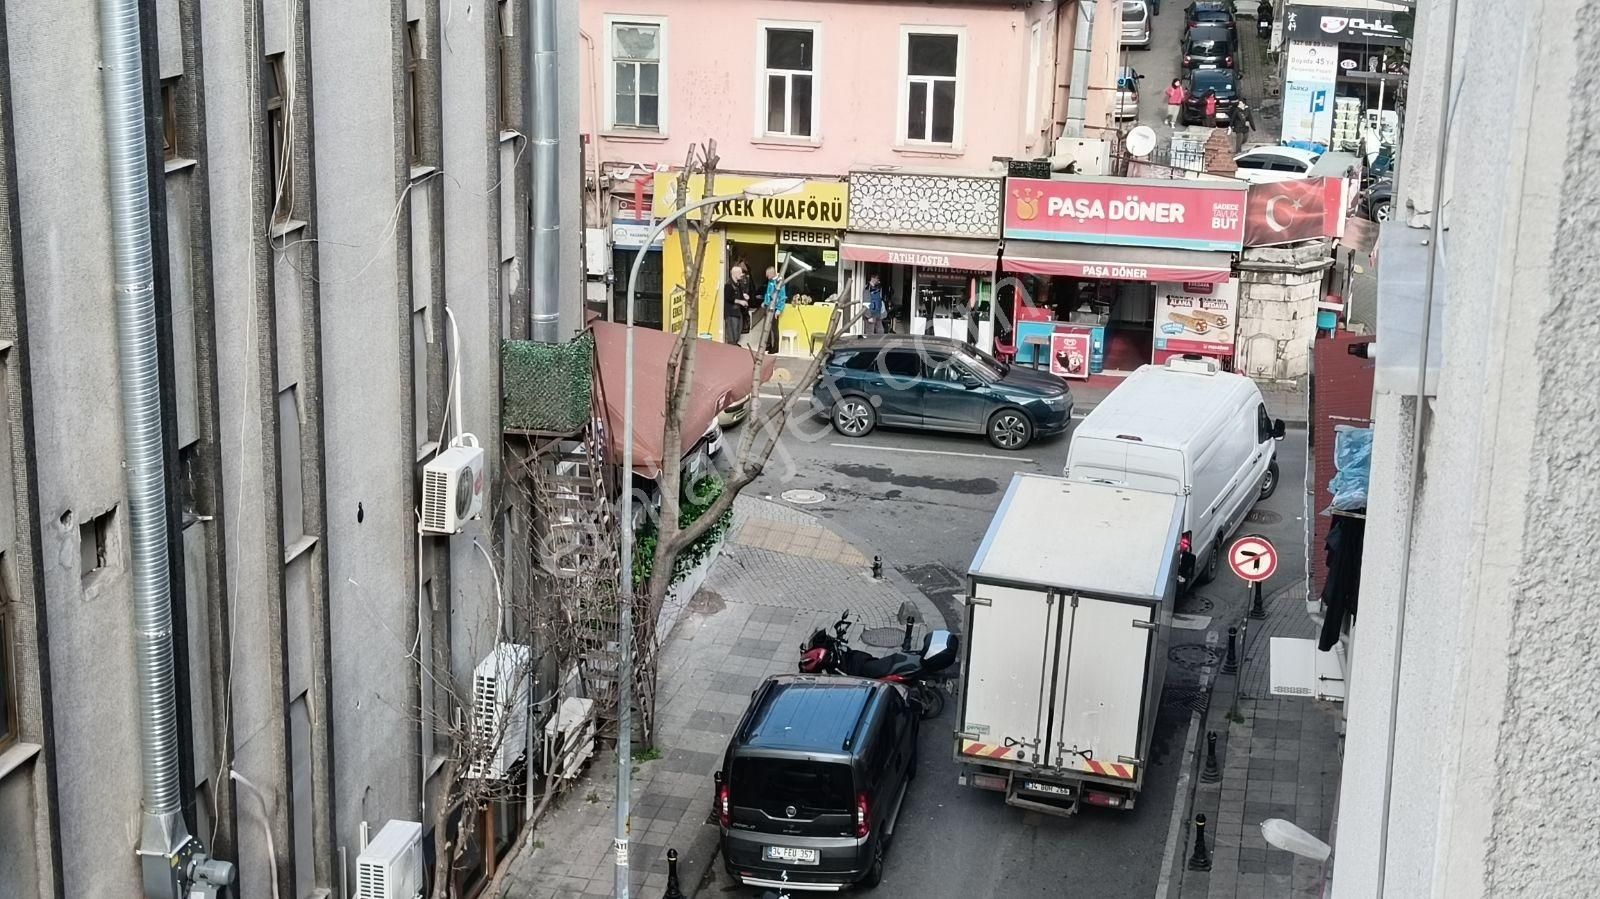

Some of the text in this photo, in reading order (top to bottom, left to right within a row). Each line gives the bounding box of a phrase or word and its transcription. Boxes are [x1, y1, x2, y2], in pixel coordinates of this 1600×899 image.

[762, 196, 842, 222] KUAFÖRÜ
[1047, 195, 1186, 223] PAŞA DÖNER
[1212, 203, 1239, 211] SADECE
[1211, 217, 1239, 230] BUT
[783, 230, 831, 244] BERBER
[916, 254, 950, 267] LOSTRA
[1082, 265, 1148, 279] PAŞA DÖNER
[773, 847, 813, 859] 34 FEU 357
